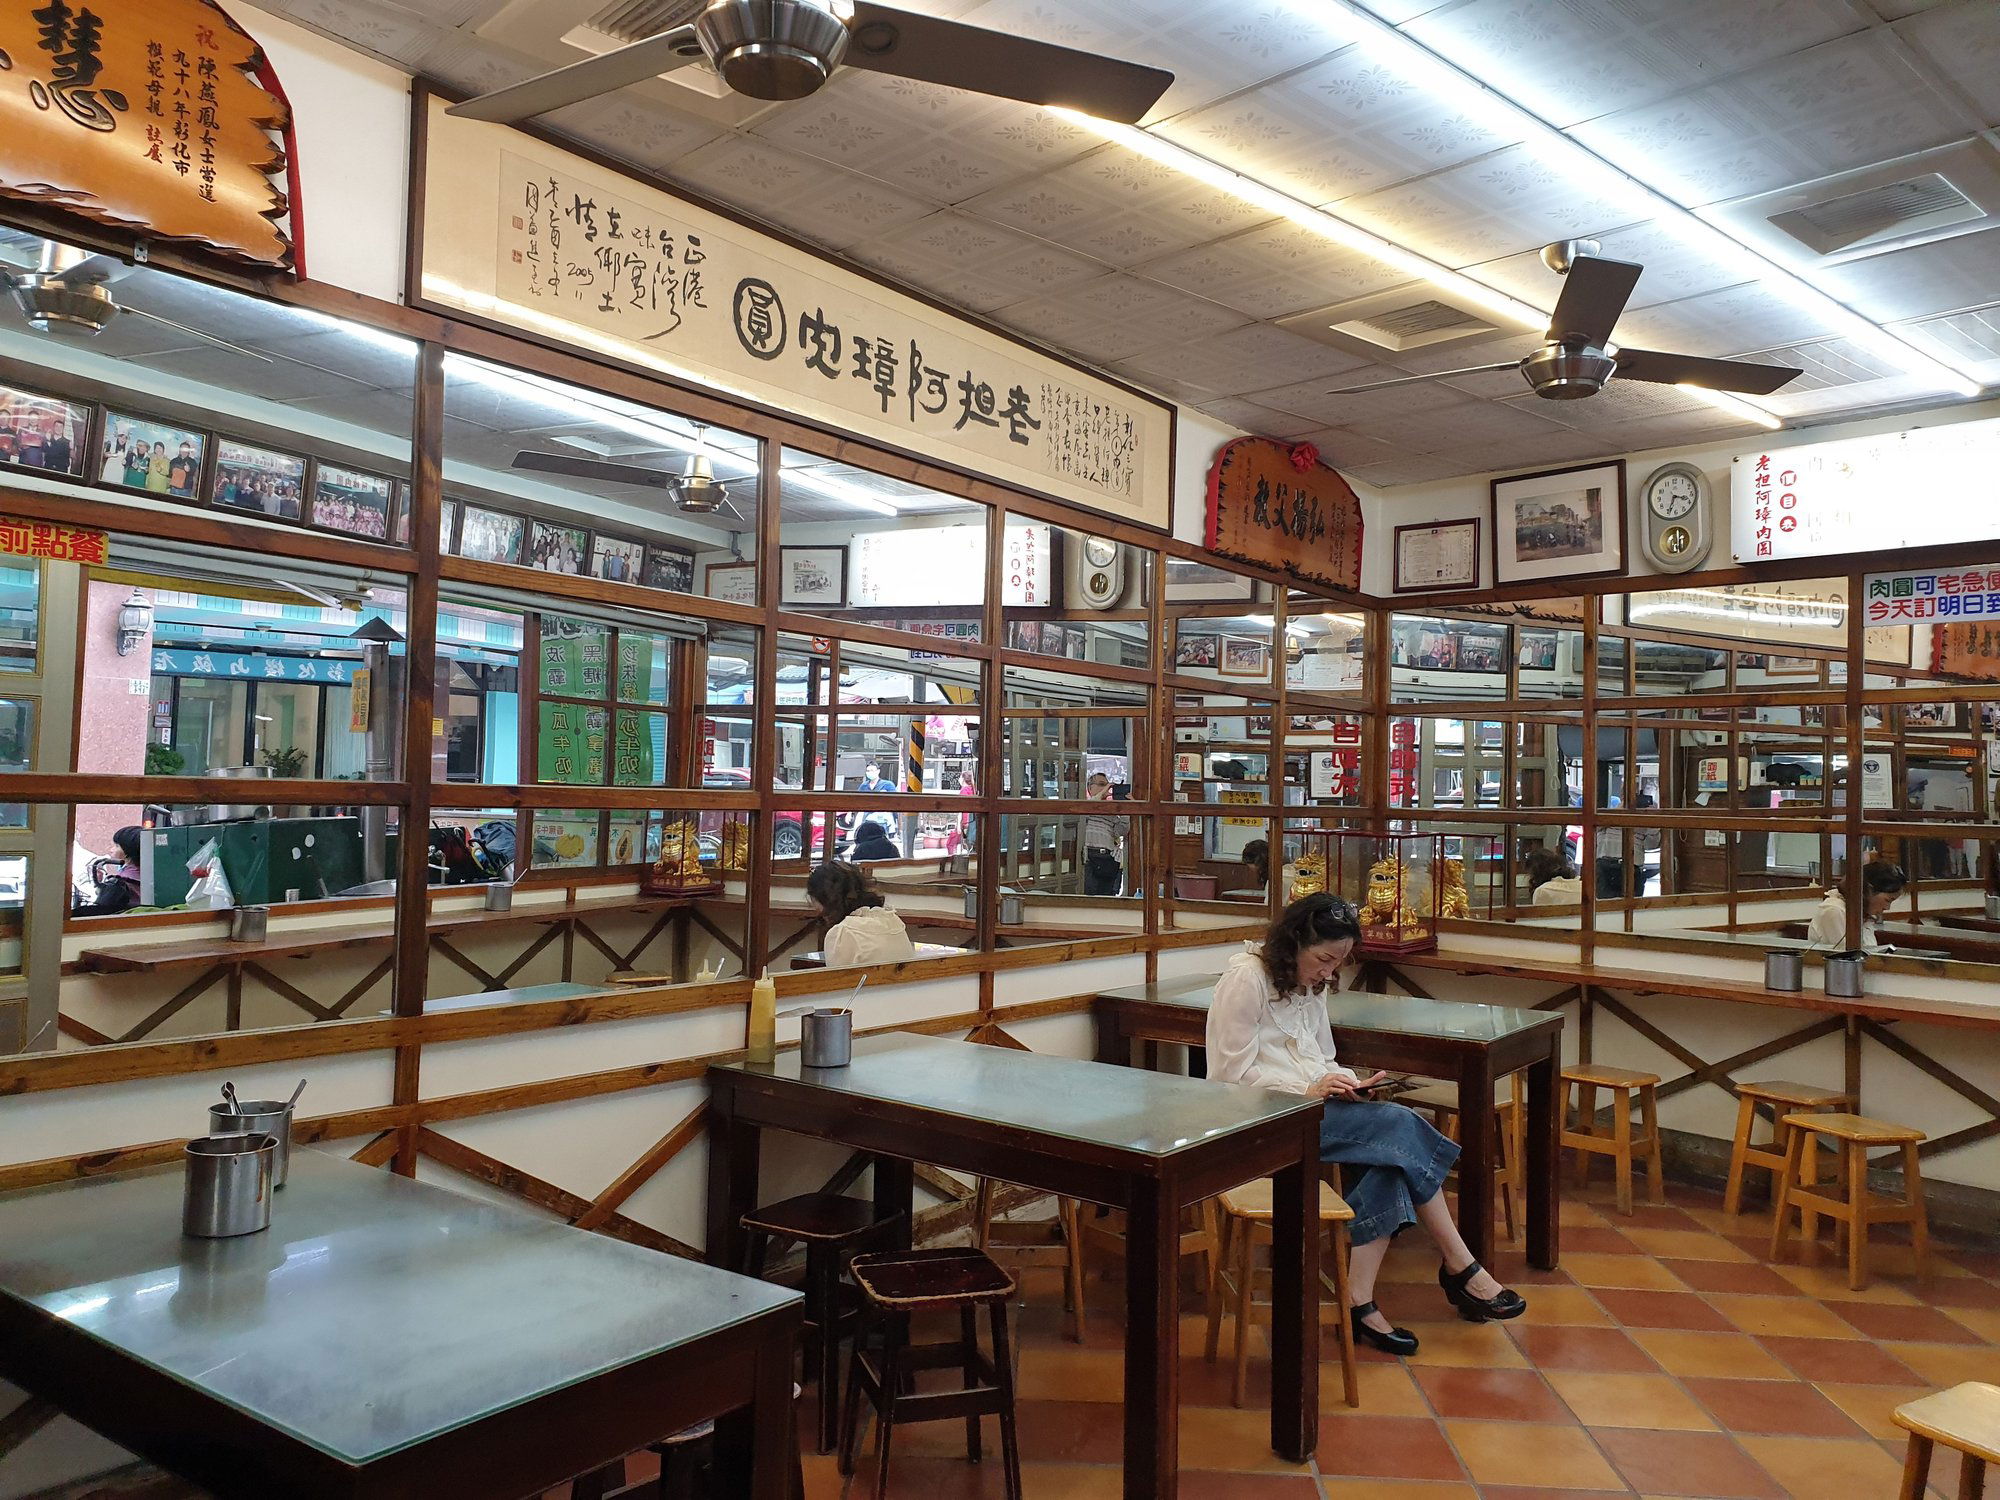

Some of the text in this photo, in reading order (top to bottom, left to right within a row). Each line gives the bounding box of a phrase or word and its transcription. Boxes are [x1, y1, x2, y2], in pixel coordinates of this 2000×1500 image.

[172, 49, 191, 177] 九十八年彰化市
[195, 24, 220, 203] 祝 陳燕鳳女士當選
[0, 517, 104, 564] 前點餐
